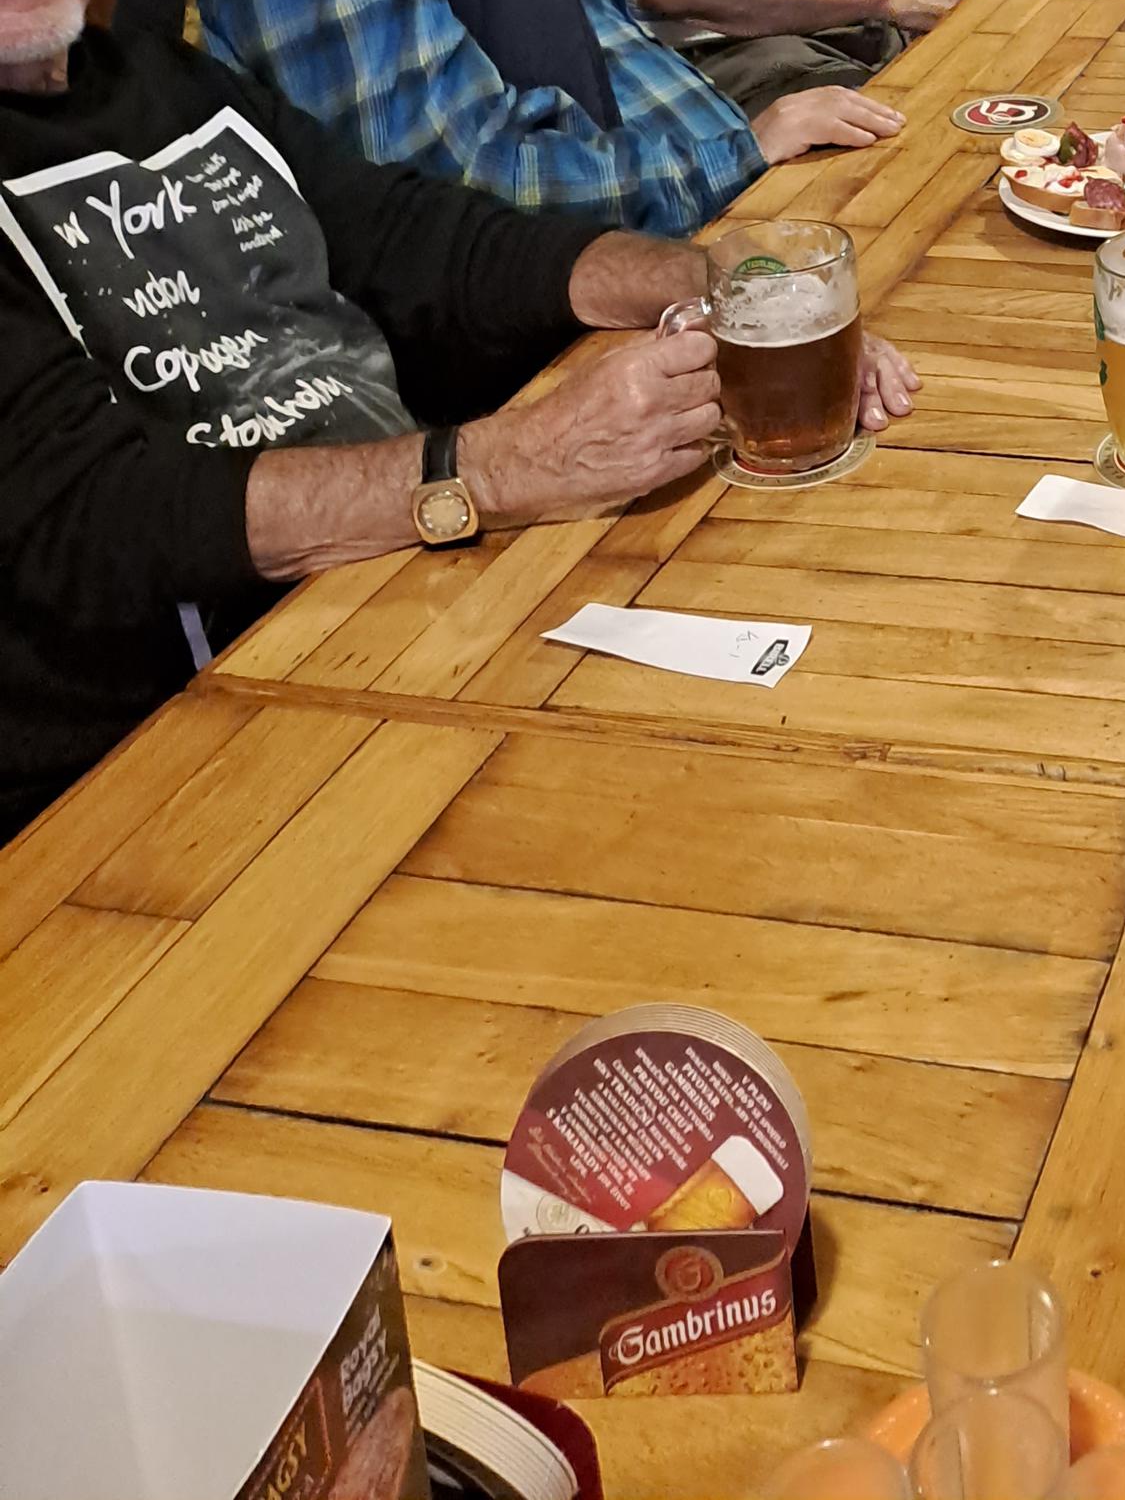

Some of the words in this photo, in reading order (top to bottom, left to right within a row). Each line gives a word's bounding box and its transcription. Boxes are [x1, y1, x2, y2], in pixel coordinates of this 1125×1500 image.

[86, 174, 197, 259] York
[632, 1064, 669, 1106] PRAVOU
[663, 1061, 716, 1121] GAMBRINUS
[681, 1062, 720, 1107] PIVOVAR
[731, 1082, 754, 1109] 1869
[609, 1288, 777, 1365] Gambrinus
